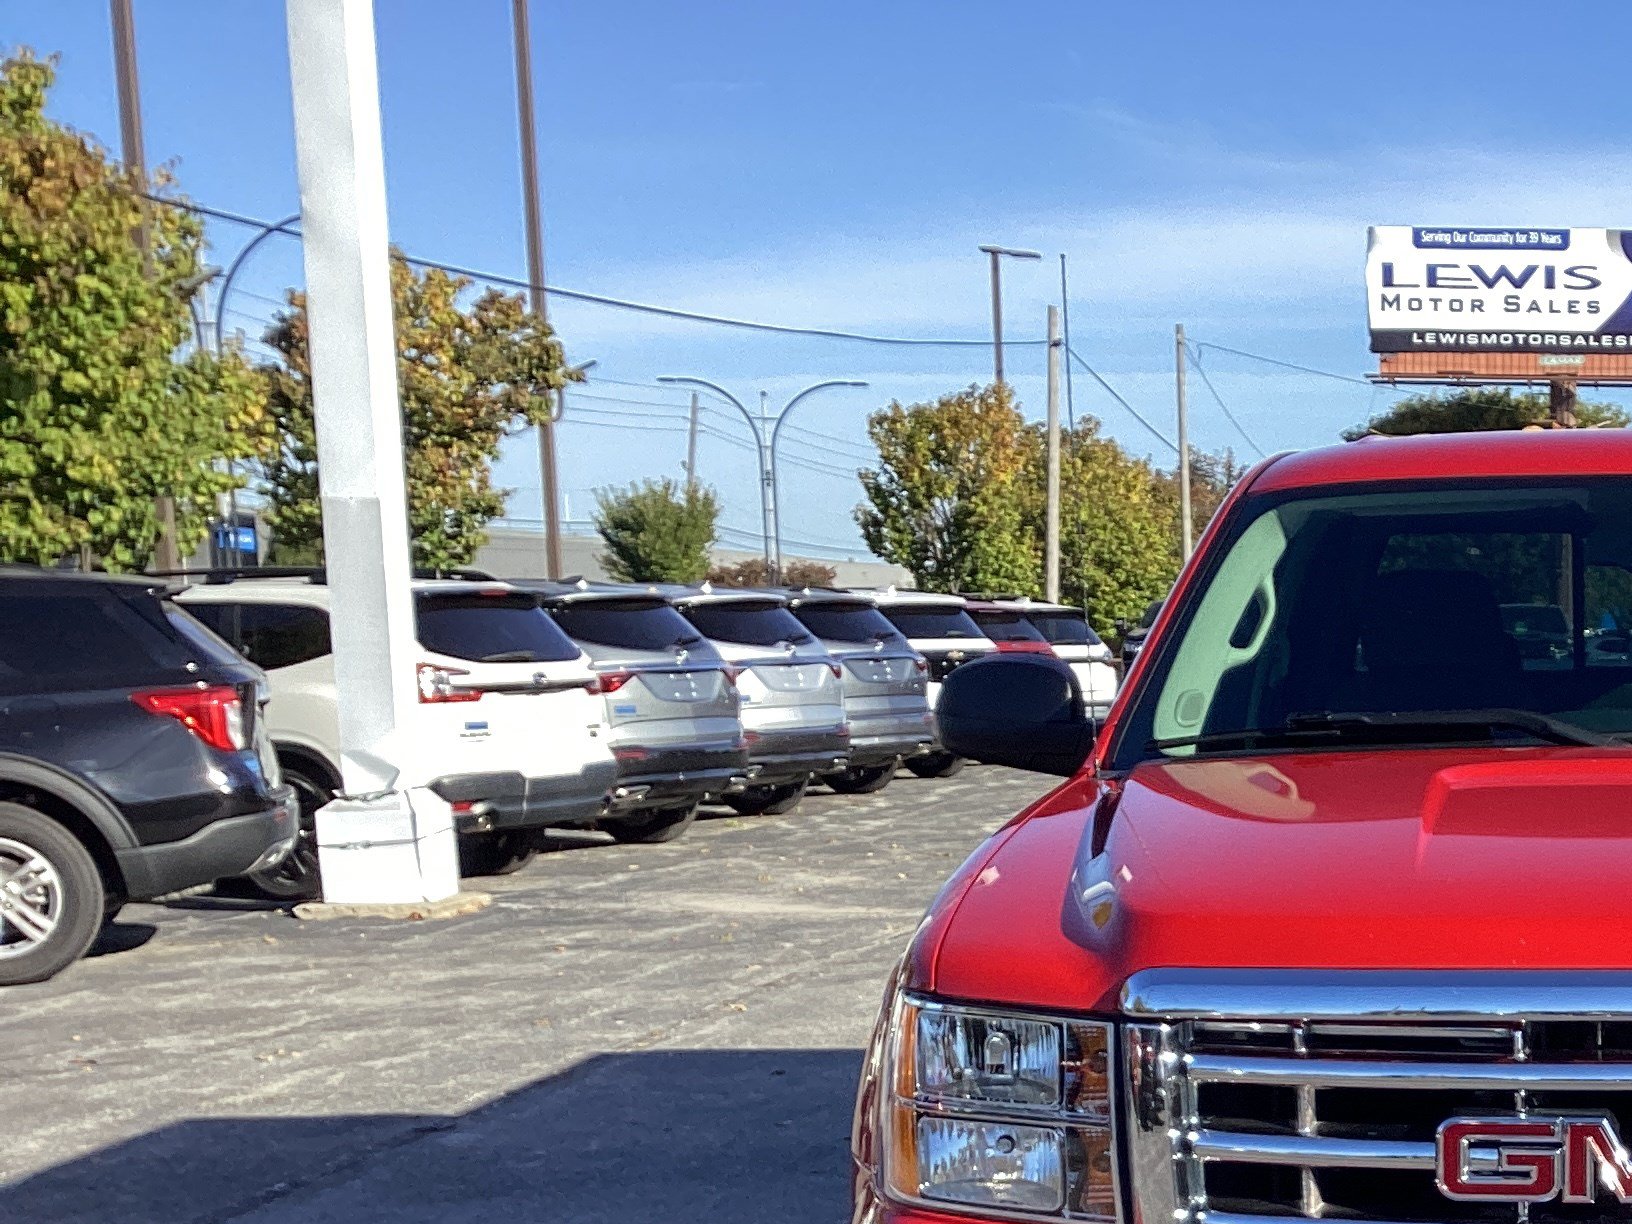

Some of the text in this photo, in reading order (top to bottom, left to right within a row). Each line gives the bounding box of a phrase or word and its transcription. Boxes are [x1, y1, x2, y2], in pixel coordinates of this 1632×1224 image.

[1421, 231, 1451, 244] Serving
[1454, 231, 1466, 243] Our
[1469, 231, 1513, 244] Community
[1516, 231, 1527, 243] for
[1540, 232, 1562, 244] Years
[1381, 262, 1602, 290] LEWIS
